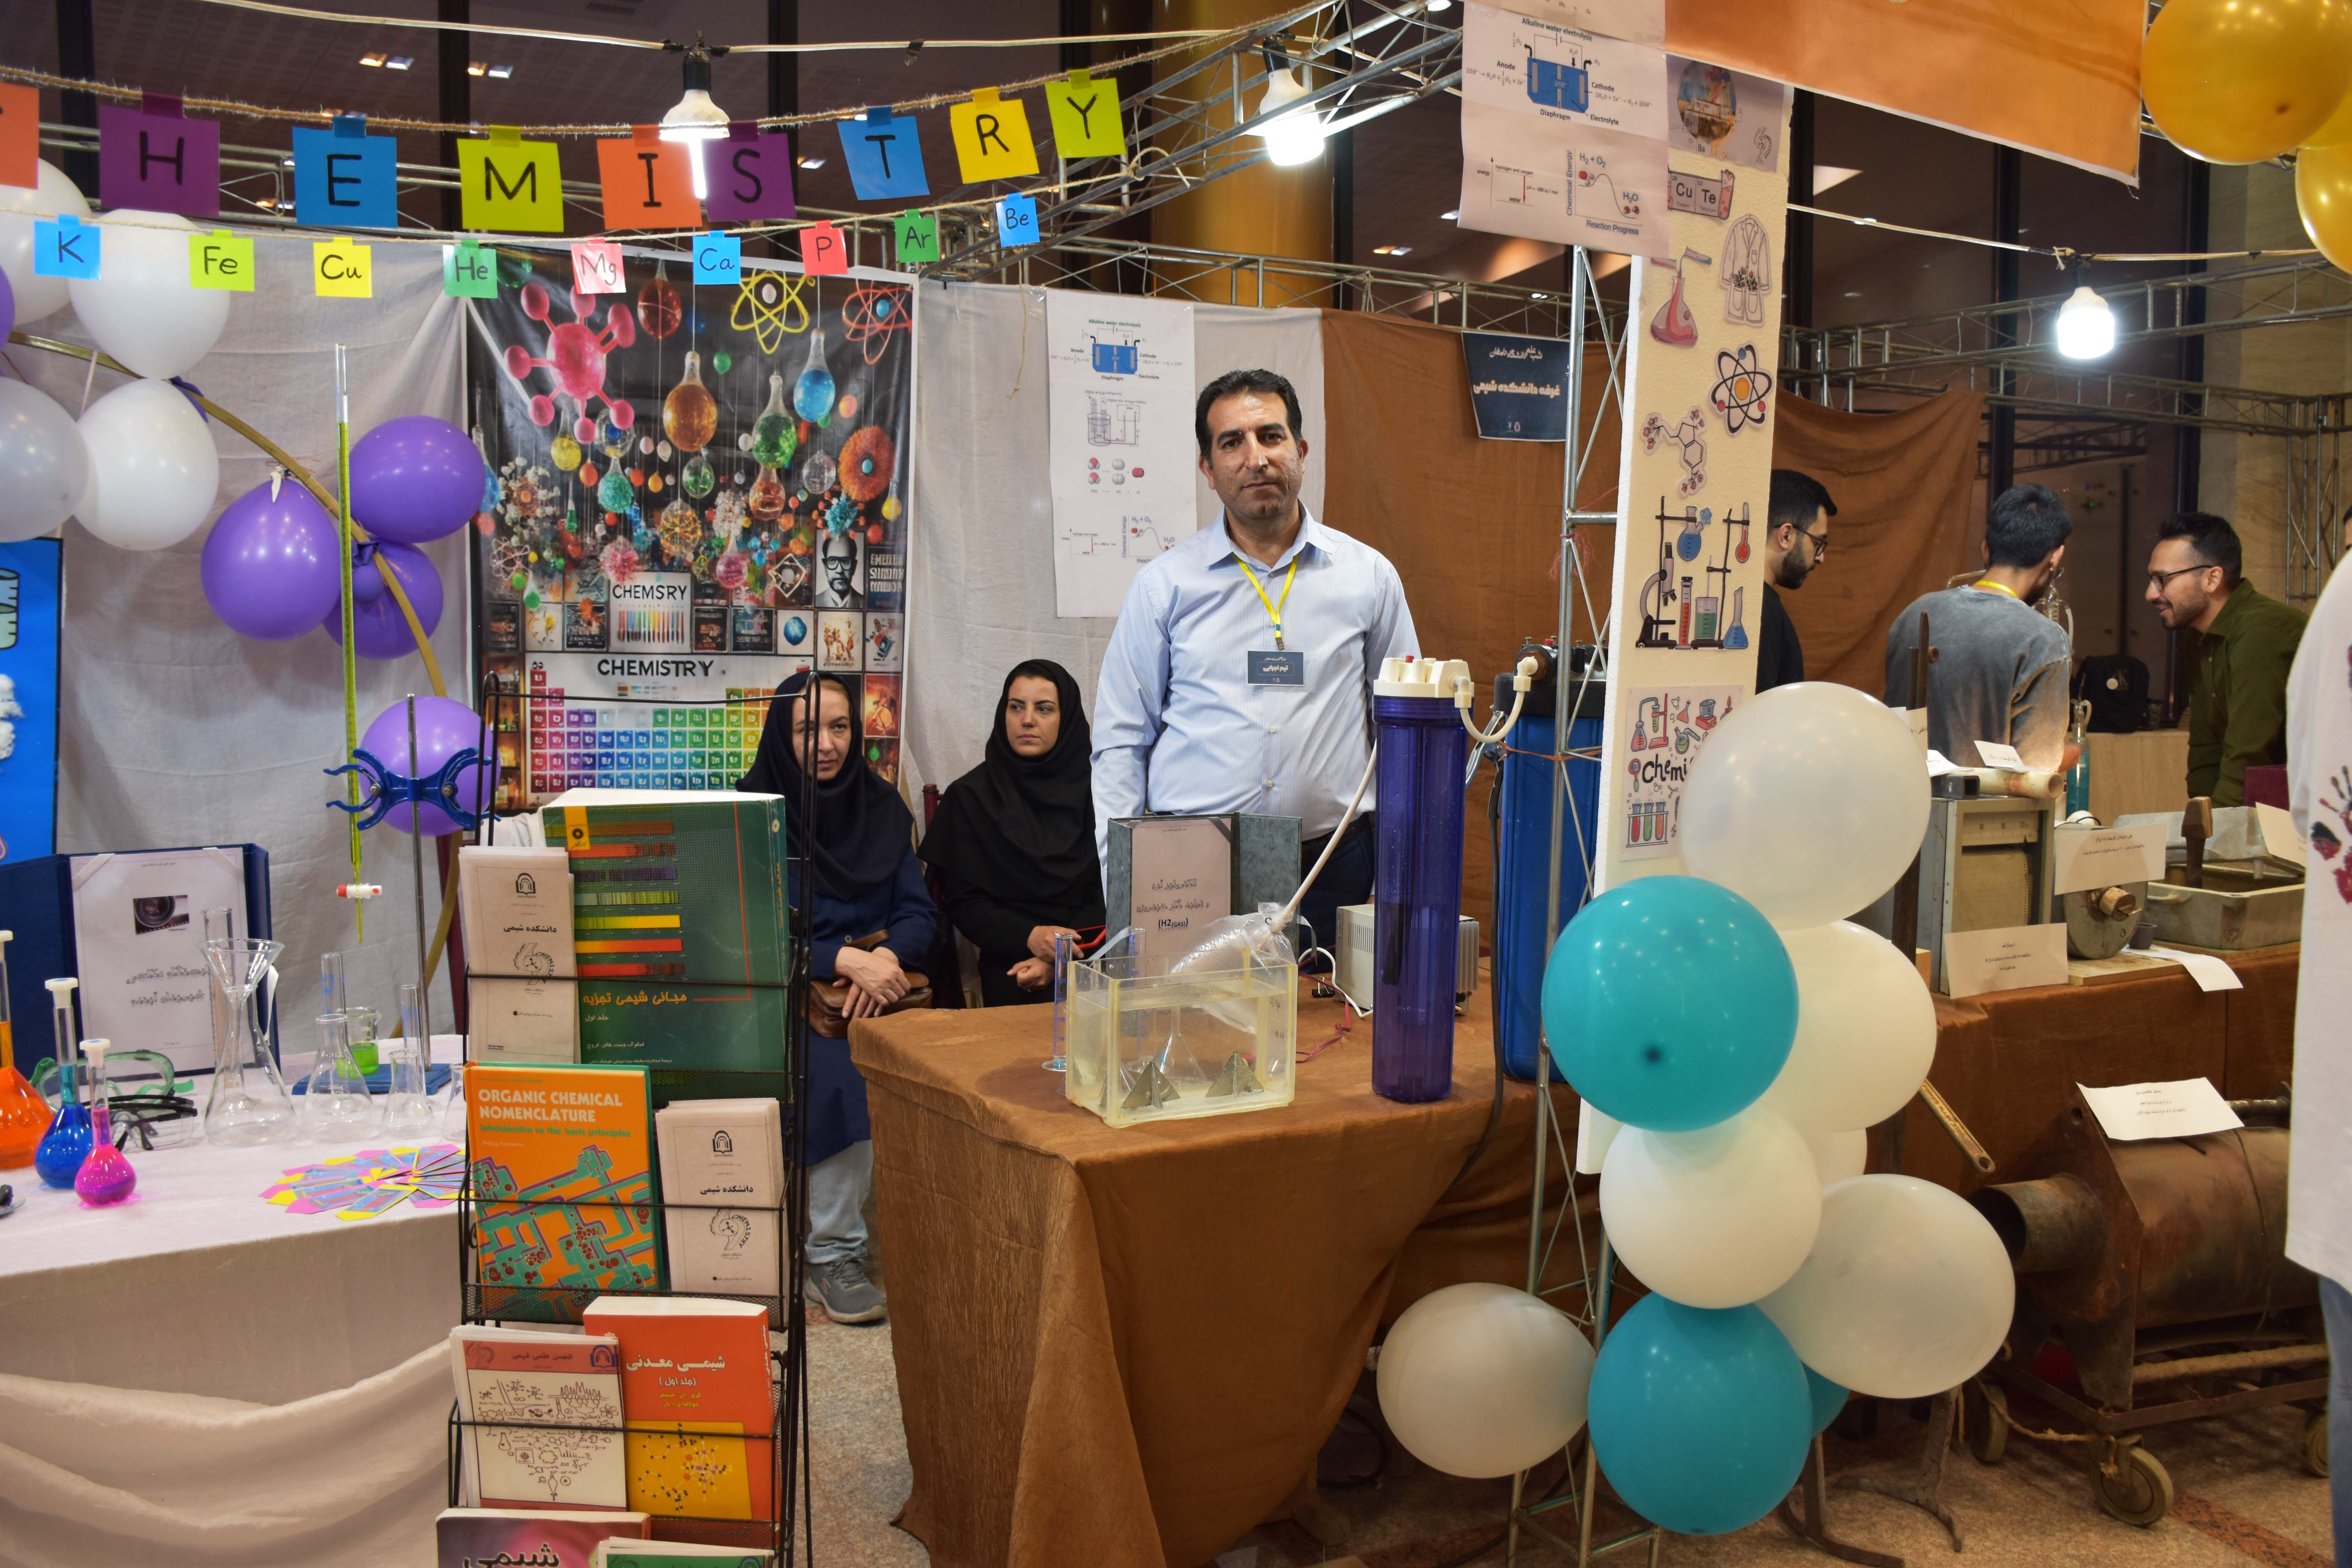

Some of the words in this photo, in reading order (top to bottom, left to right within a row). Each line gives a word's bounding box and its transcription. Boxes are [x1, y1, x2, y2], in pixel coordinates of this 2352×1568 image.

[1522, 18, 1544, 29] Alkaline
[1546, 24, 1562, 33] water
[1563, 29, 1592, 42] electrolysis
[1497, 61, 1515, 71] Anode
[1592, 82, 1615, 92] Cathode
[1540, 109, 1570, 121] Diaphragm
[1590, 114, 1619, 126] Electrolyte
[1698, 144, 1705, 152] Ba
[1579, 153, 1588, 164] H2
[1597, 157, 1606, 168] O2
[1495, 165, 1512, 173] hydrogen
[1623, 192, 1638, 202] H2O
[1676, 183, 1692, 198] Cu
[1702, 189, 1716, 204] Te
[1005, 207, 1029, 228] Be
[1586, 220, 1611, 231] Reaction
[1613, 226, 1639, 235] Progress
[905, 228, 931, 250] Ar
[57, 232, 84, 264] K
[817, 237, 832, 263] P
[203, 247, 238, 276] Fe
[321, 255, 363, 280] Cu
[699, 248, 735, 272] Ca
[455, 255, 488, 284] He
[581, 254, 618, 286] Mg
[1473, 379, 1497, 394] شیمی
[1498, 382, 1538, 395] دانشکده
[1539, 384, 1561, 399] غرفه
[613, 584, 687, 600] CHEMSRY
[597, 659, 714, 677] CHEMISTRY
[1152, 880, 1163, 890] آب
[1169, 899, 1183, 911] گاز
[1185, 899, 1203, 909] تولید
[503, 924, 524, 933] شیمی
[583, 992, 612, 1006] تجزیه
[616, 990, 648, 1005] شیمی
[653, 991, 687, 1005] مبانی
[479, 1089, 546, 1104] ORGANIC
[550, 1091, 622, 1106] CHEMICAL
[480, 1107, 595, 1122] NOMENCLATURE
[481, 1124, 533, 1133] Introduction
[548, 1126, 561, 1134] the
[566, 1127, 586, 1135] basic
[589, 1129, 631, 1138] principles
[700, 1185, 720, 1195] شیمی
[723, 1185, 753, 1194] دانشکده
[731, 1214, 751, 1248] CHEMISTRY
[626, 1354, 673, 1371] معدنی
[677, 1356, 725, 1372] شیمی
